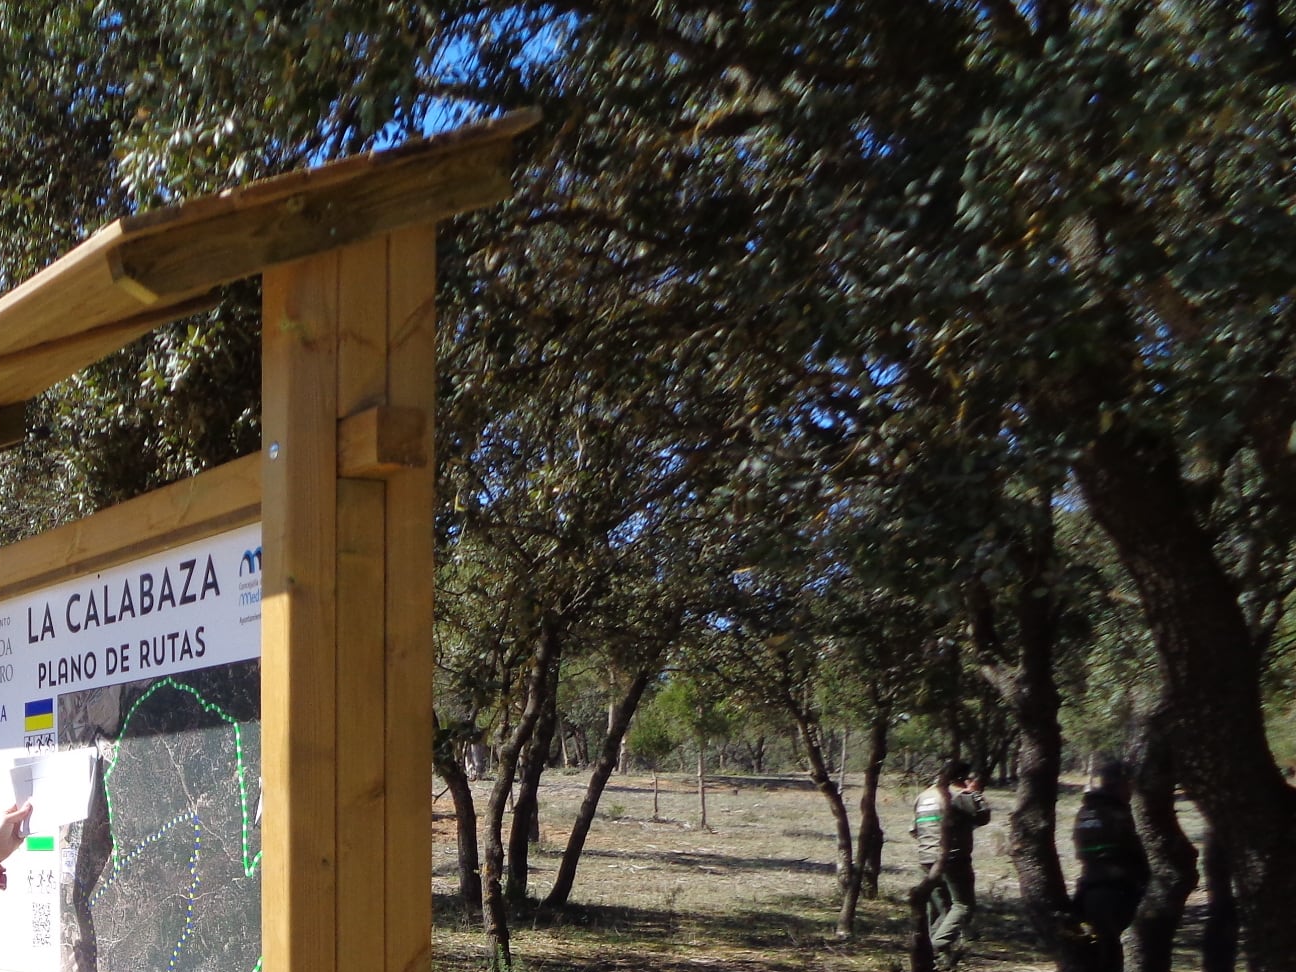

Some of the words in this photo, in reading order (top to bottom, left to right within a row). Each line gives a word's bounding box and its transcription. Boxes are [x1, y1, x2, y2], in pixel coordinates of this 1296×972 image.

[27, 601, 55, 644] LA
[65, 553, 221, 634] CALABAZA
[38, 651, 97, 688] PLANO
[106, 644, 130, 676] DE
[140, 626, 206, 670] RUTAS
